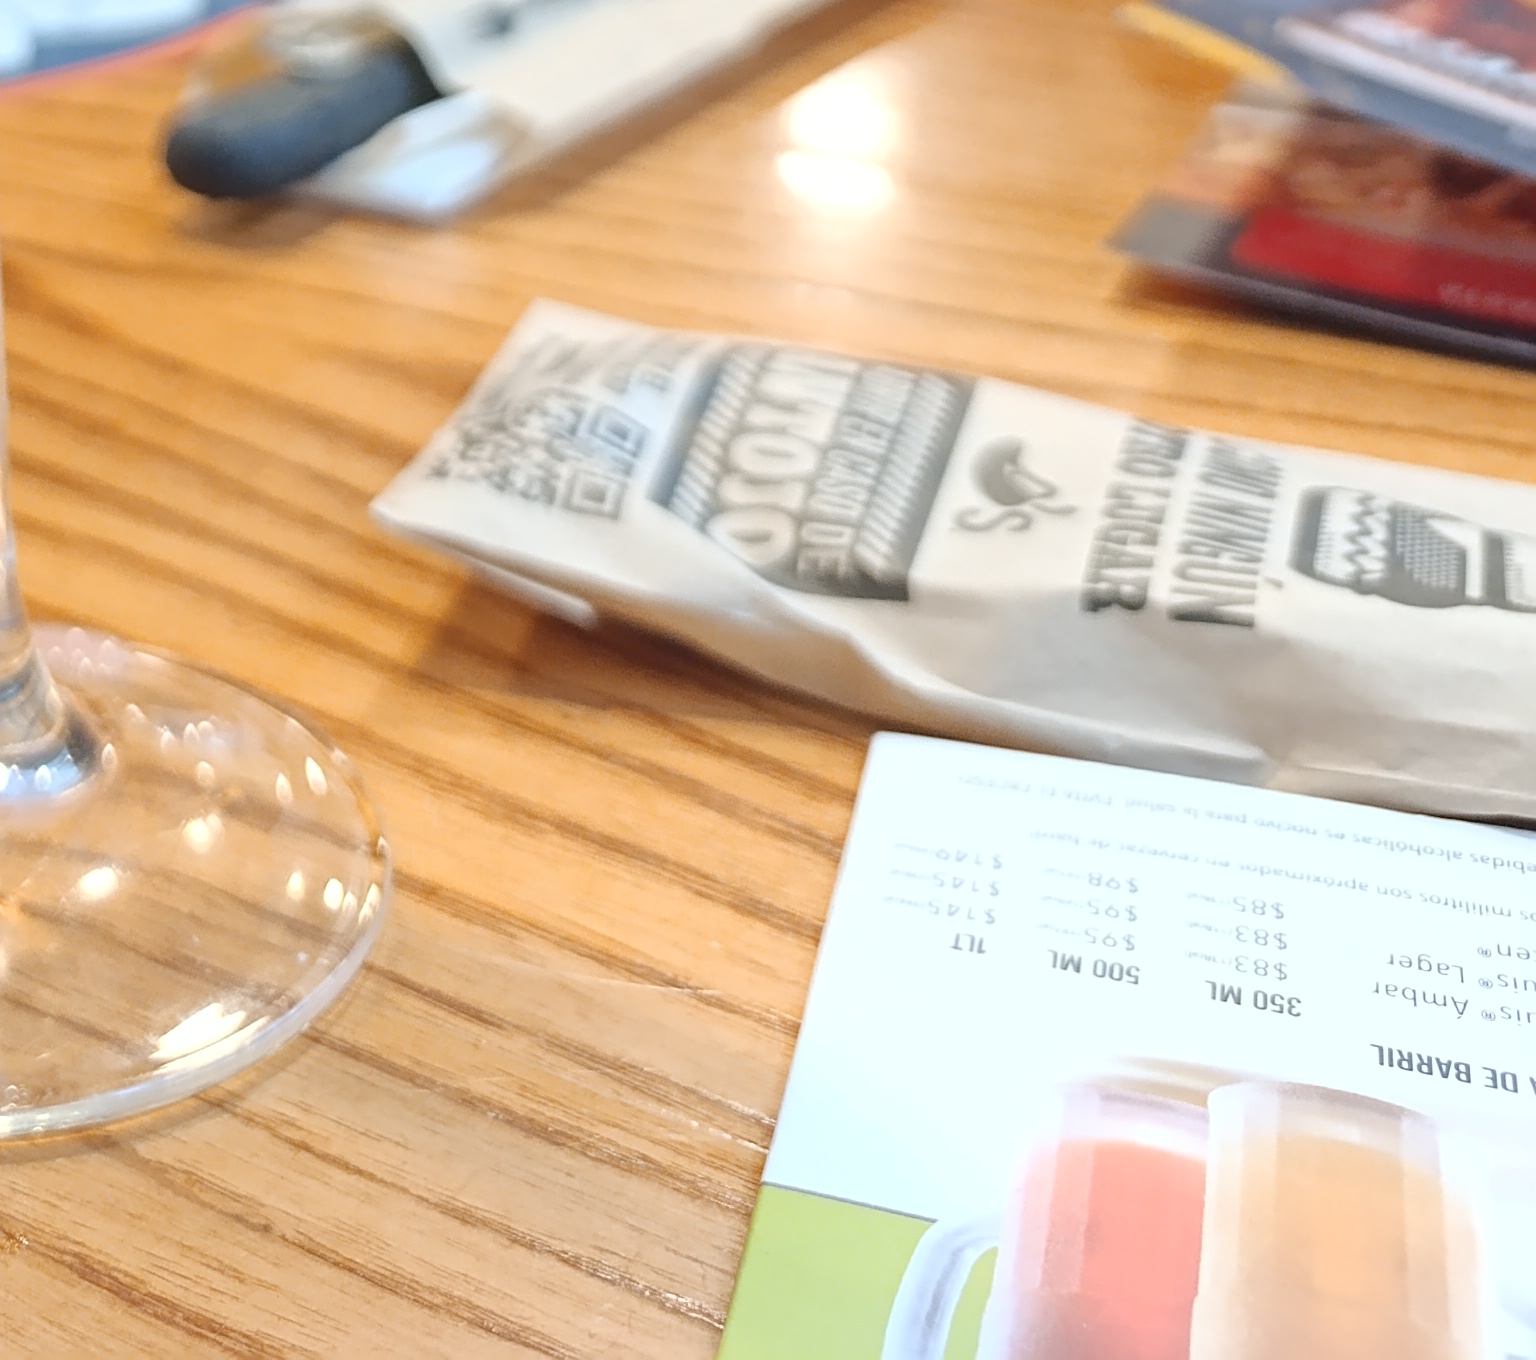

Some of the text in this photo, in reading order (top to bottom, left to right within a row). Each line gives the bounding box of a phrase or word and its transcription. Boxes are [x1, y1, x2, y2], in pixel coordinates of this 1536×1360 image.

[1080, 482, 1171, 612] LUGAR
[1352, 833, 1463, 861] alcohólicas
[1376, 886, 1413, 900] son
[1419, 892, 1512, 917] mililitros
[1087, 899, 1137, 922] $95
[1232, 896, 1284, 919] $85
[950, 932, 986, 954] 1LT
[1084, 927, 1135, 952] $95
[1234, 925, 1288, 950] $83
[1047, 949, 1140, 985] 500 ML
[1234, 955, 1288, 981] $83
[1386, 953, 1464, 983] Lager
[1205, 980, 1302, 1017] 350 ML
[1372, 981, 1468, 1019] Ámbar
[1370, 1043, 1472, 1084] BARRIL
[1482, 1066, 1519, 1094] DE
